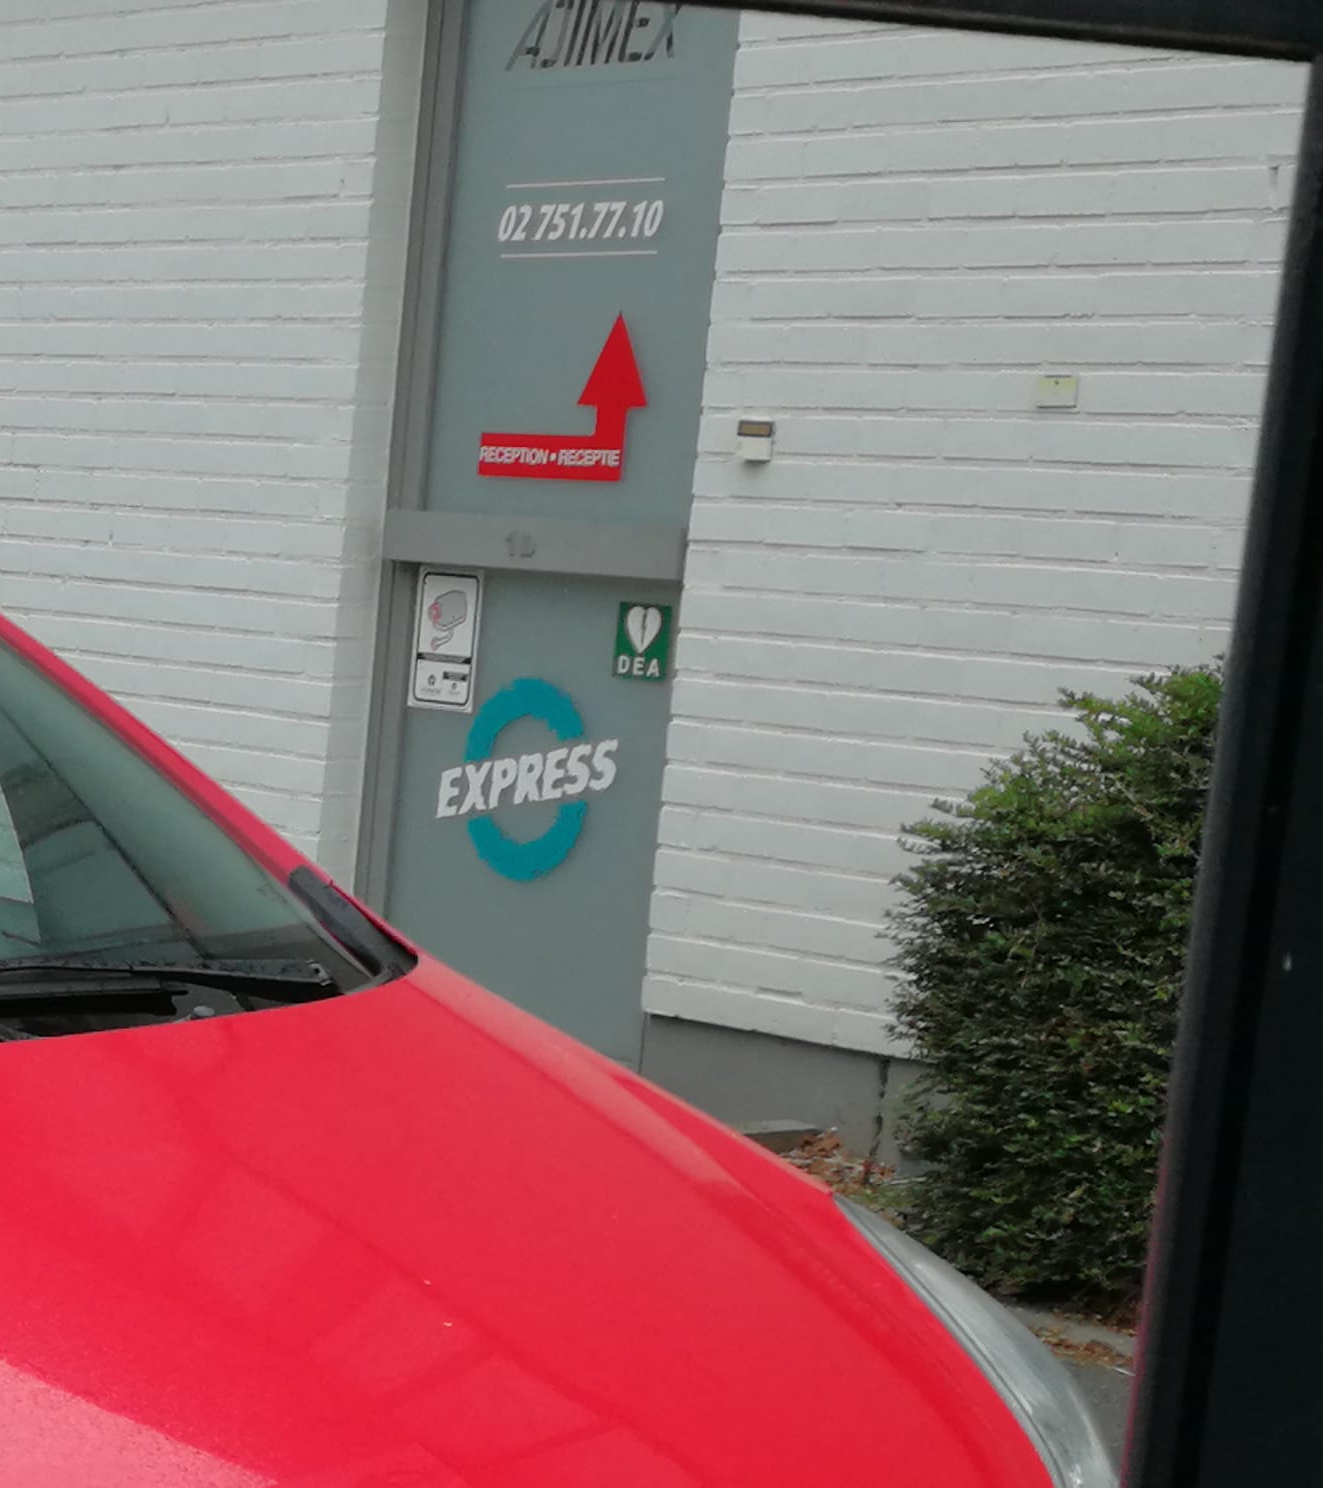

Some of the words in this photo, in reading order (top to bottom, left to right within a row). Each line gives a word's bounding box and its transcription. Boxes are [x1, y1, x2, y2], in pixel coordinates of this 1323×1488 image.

[498, 204, 532, 241] 02
[532, 200, 664, 241] 751.77.10
[479, 446, 549, 464] RECEPTION
[558, 449, 620, 466] RECEPTIE
[617, 655, 660, 676] DEA
[435, 739, 618, 818] EXPRESS
